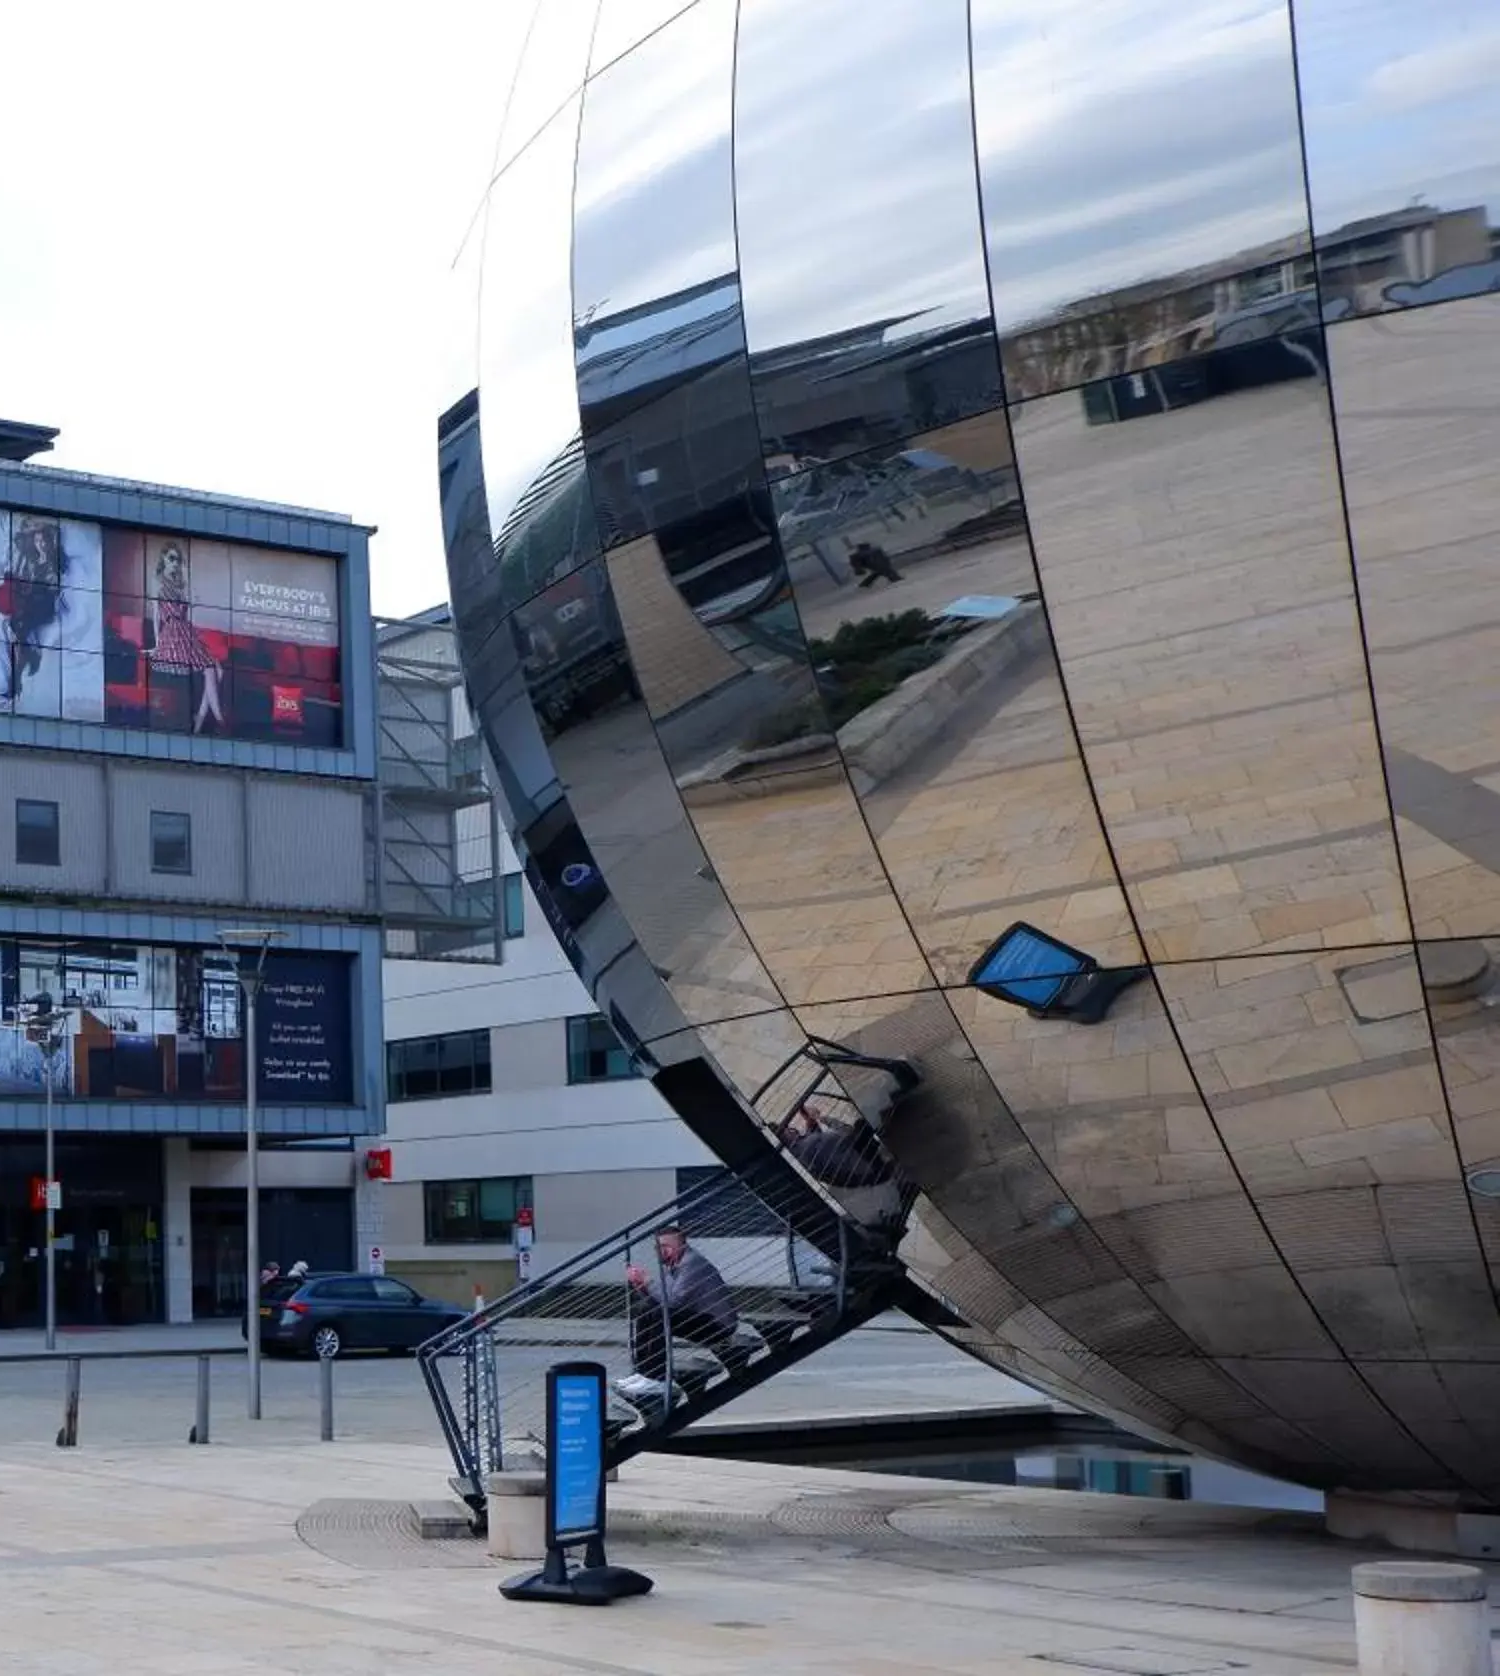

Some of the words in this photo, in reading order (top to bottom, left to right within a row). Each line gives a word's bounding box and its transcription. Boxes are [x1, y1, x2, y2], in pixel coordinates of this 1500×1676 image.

[244, 580, 327, 604] EVERYBODY'S
[241, 595, 289, 612] FAMOUS
[292, 603, 306, 615] AT
[285, 984, 303, 994] FREE
